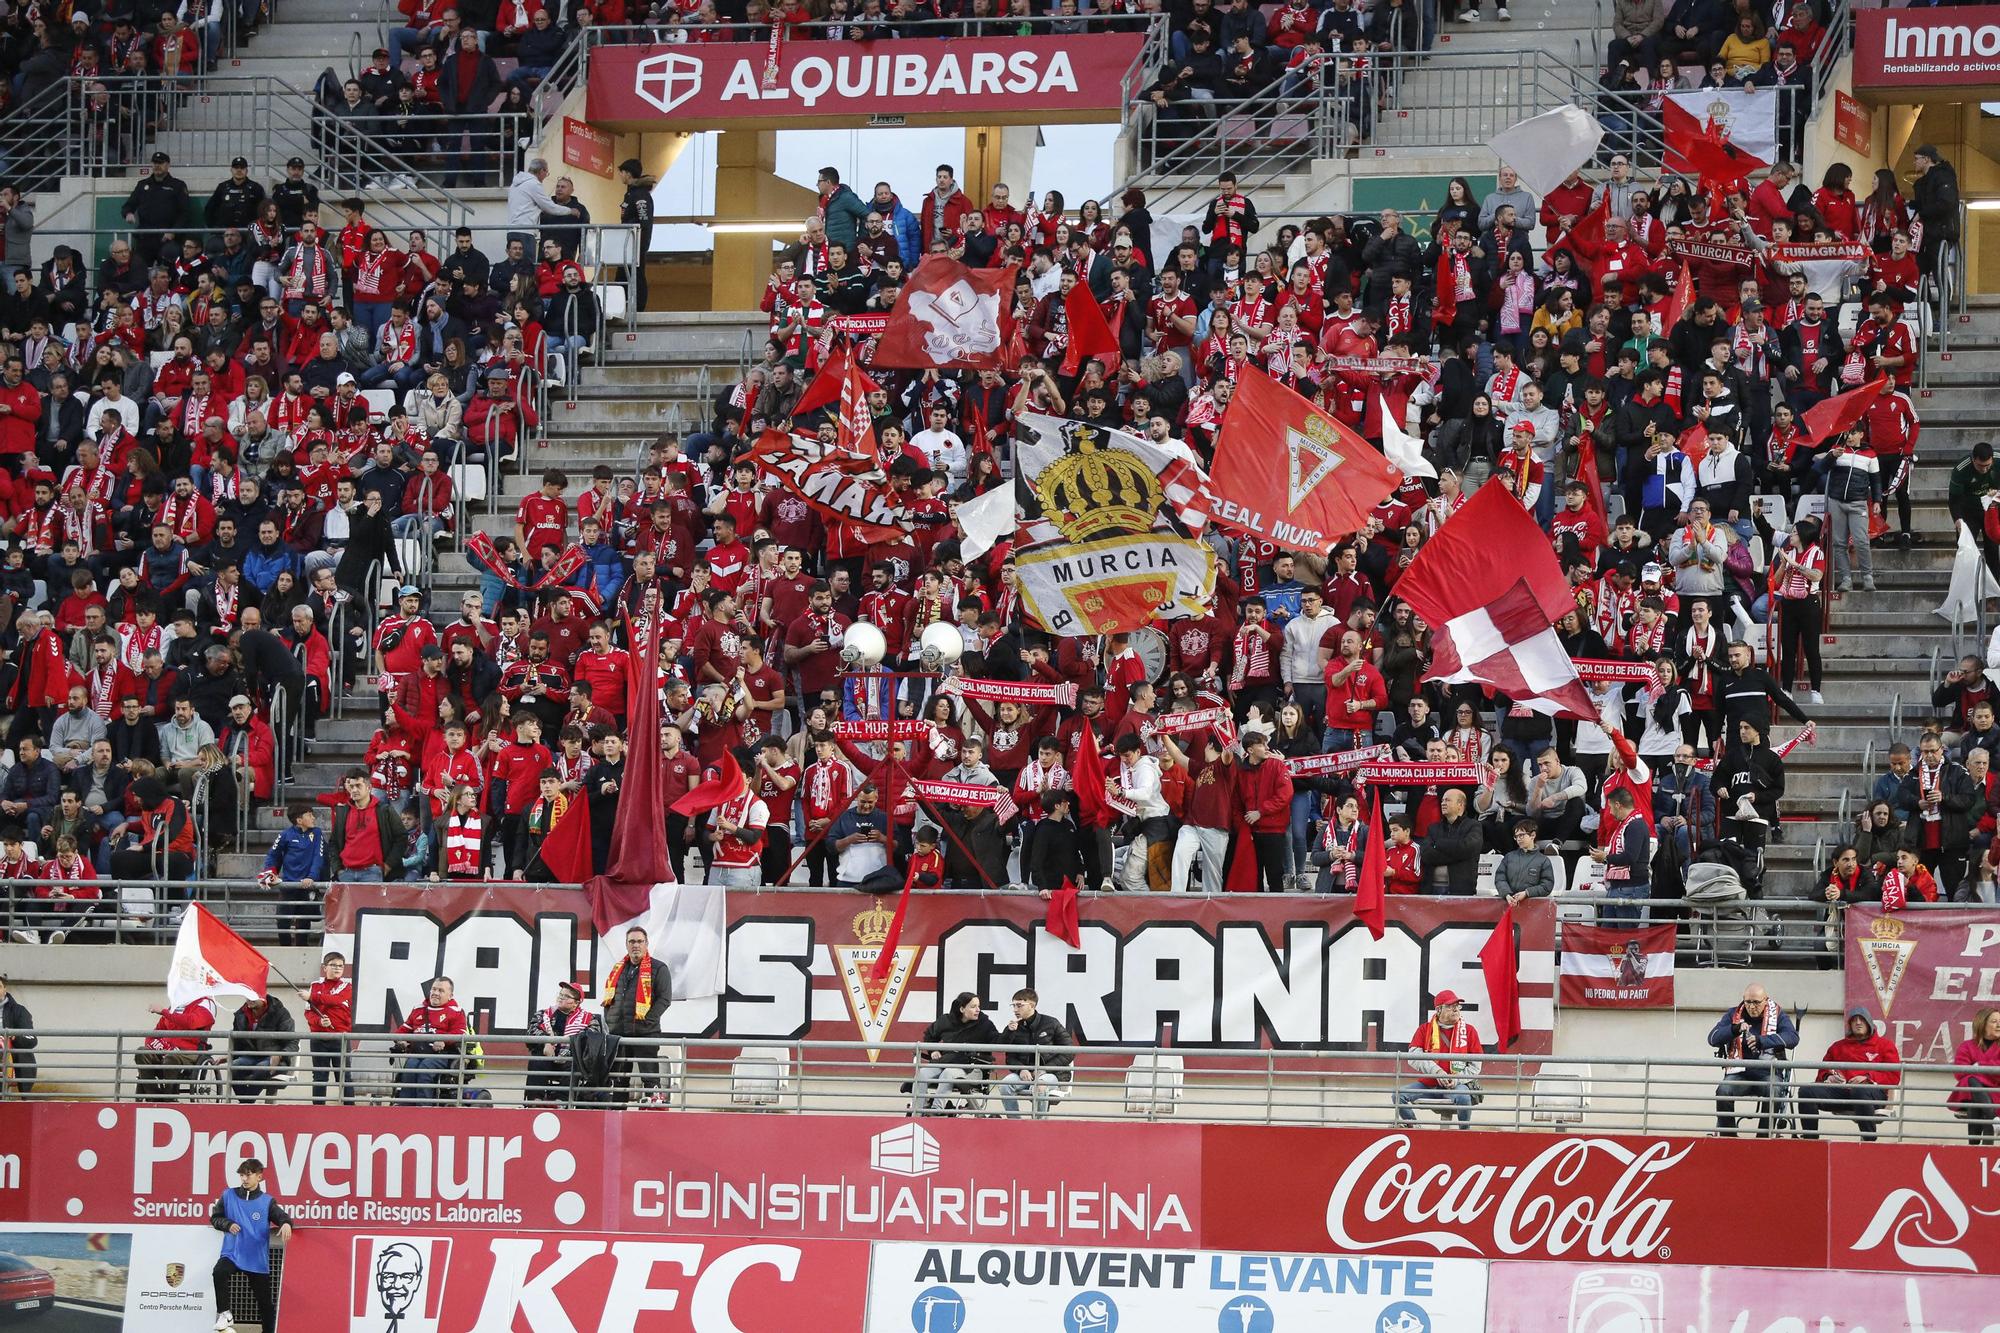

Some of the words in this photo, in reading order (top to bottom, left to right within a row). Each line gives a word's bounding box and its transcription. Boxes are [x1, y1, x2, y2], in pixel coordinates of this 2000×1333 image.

[1884, 63, 1960, 73] Rentabilizando
[1694, 243, 1733, 260] MURCIA
[1783, 243, 1863, 257] FURIAGRANA
[1300, 437, 1328, 459] MURCIA
[1209, 495, 1264, 533] REAL
[1052, 547, 1178, 584] MURCIA
[1594, 665, 1615, 675] CLUB
[1616, 666, 1626, 675] DE
[960, 681, 976, 691] REAL
[977, 683, 1002, 693] MURCIA
[1003, 685, 1021, 695] CLUB
[1021, 686, 1030, 696] DE
[1188, 709, 1216, 723] MURCI
[832, 721, 863, 734] REAL
[1361, 767, 1380, 777] REAL
[1382, 767, 1412, 777] MURCIA
[1414, 767, 1435, 777] CLUB
[1435, 767, 1446, 777] DE
[1447, 765, 1477, 777] FÚTBOL
[926, 785, 950, 797] MURCIA
[951, 787, 968, 798] CLUB
[969, 789, 978, 799] DE
[852, 950, 900, 959] MURA
[847, 968, 872, 1028] CLUB
[876, 966, 907, 1028] FUTBOL
[1619, 989, 1628, 999] NO
[134, 1107, 523, 1201] Prevemur
[633, 1172, 1192, 1236] CONSTUARCHENA
[1326, 1133, 1695, 1259] Coca-Cola
[133, 1197, 204, 1218] Servicio
[337, 1200, 360, 1222] de
[363, 1201, 431, 1226] Riesgos
[434, 1203, 522, 1224] Laborales
[915, 1248, 1195, 1289] ALQUIVENT
[1210, 1255, 1433, 1297] LEVANTE
[473, 1237, 802, 1333] KFC
[139, 1303, 157, 1311] Centro
[159, 1303, 182, 1312] Porsche
[183, 1303, 203, 1311] Murcia
